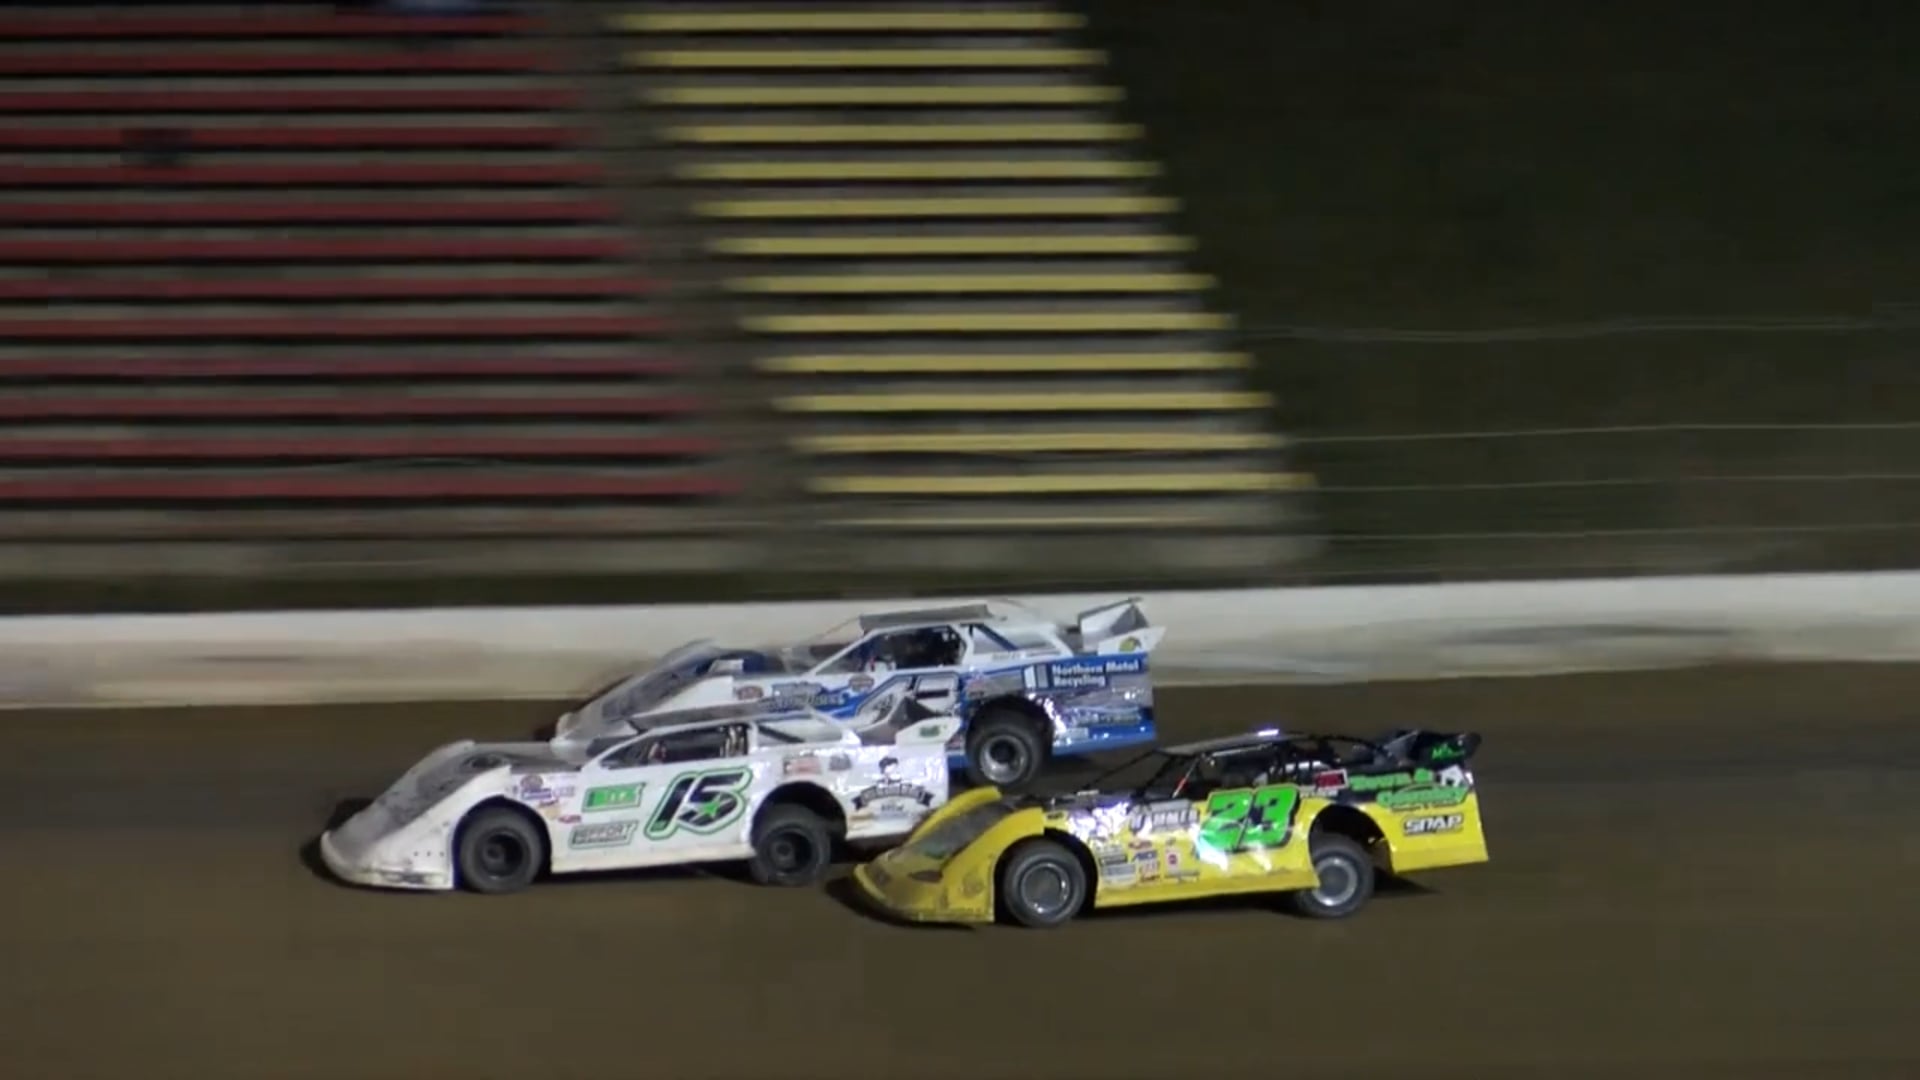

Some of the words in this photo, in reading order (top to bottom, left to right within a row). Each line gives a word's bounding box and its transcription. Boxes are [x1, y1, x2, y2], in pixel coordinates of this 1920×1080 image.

[1052, 664, 1104, 677] Northern
[1106, 660, 1139, 673] Metal
[1054, 675, 1106, 688] Recycling
[643, 766, 753, 840] 15
[1199, 783, 1300, 852] 23
